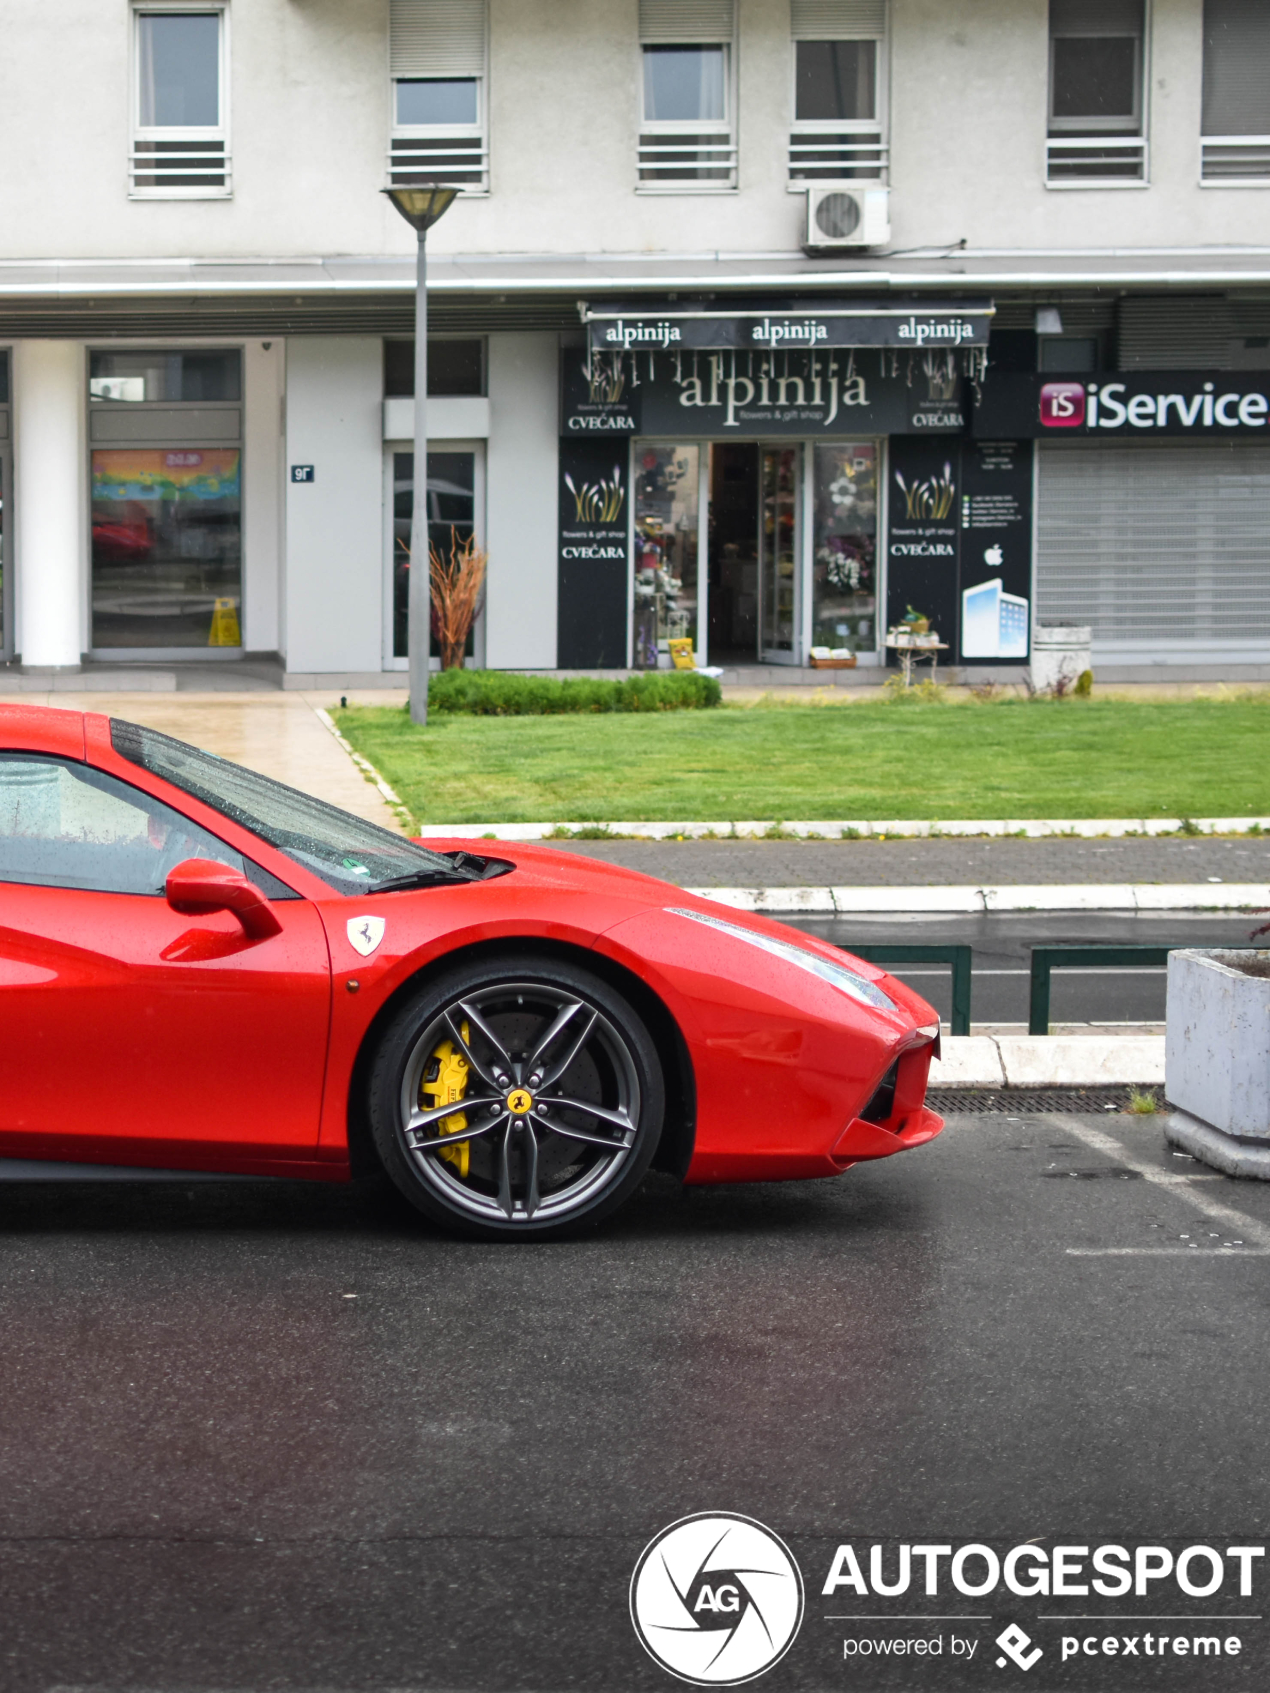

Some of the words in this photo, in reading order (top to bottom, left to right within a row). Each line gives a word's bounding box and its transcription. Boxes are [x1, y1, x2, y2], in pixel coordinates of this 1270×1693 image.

[606, 320, 681, 347] alpinija
[752, 318, 828, 346] alpinija
[898, 317, 974, 345] alpinija
[679, 355, 870, 426] alpinija
